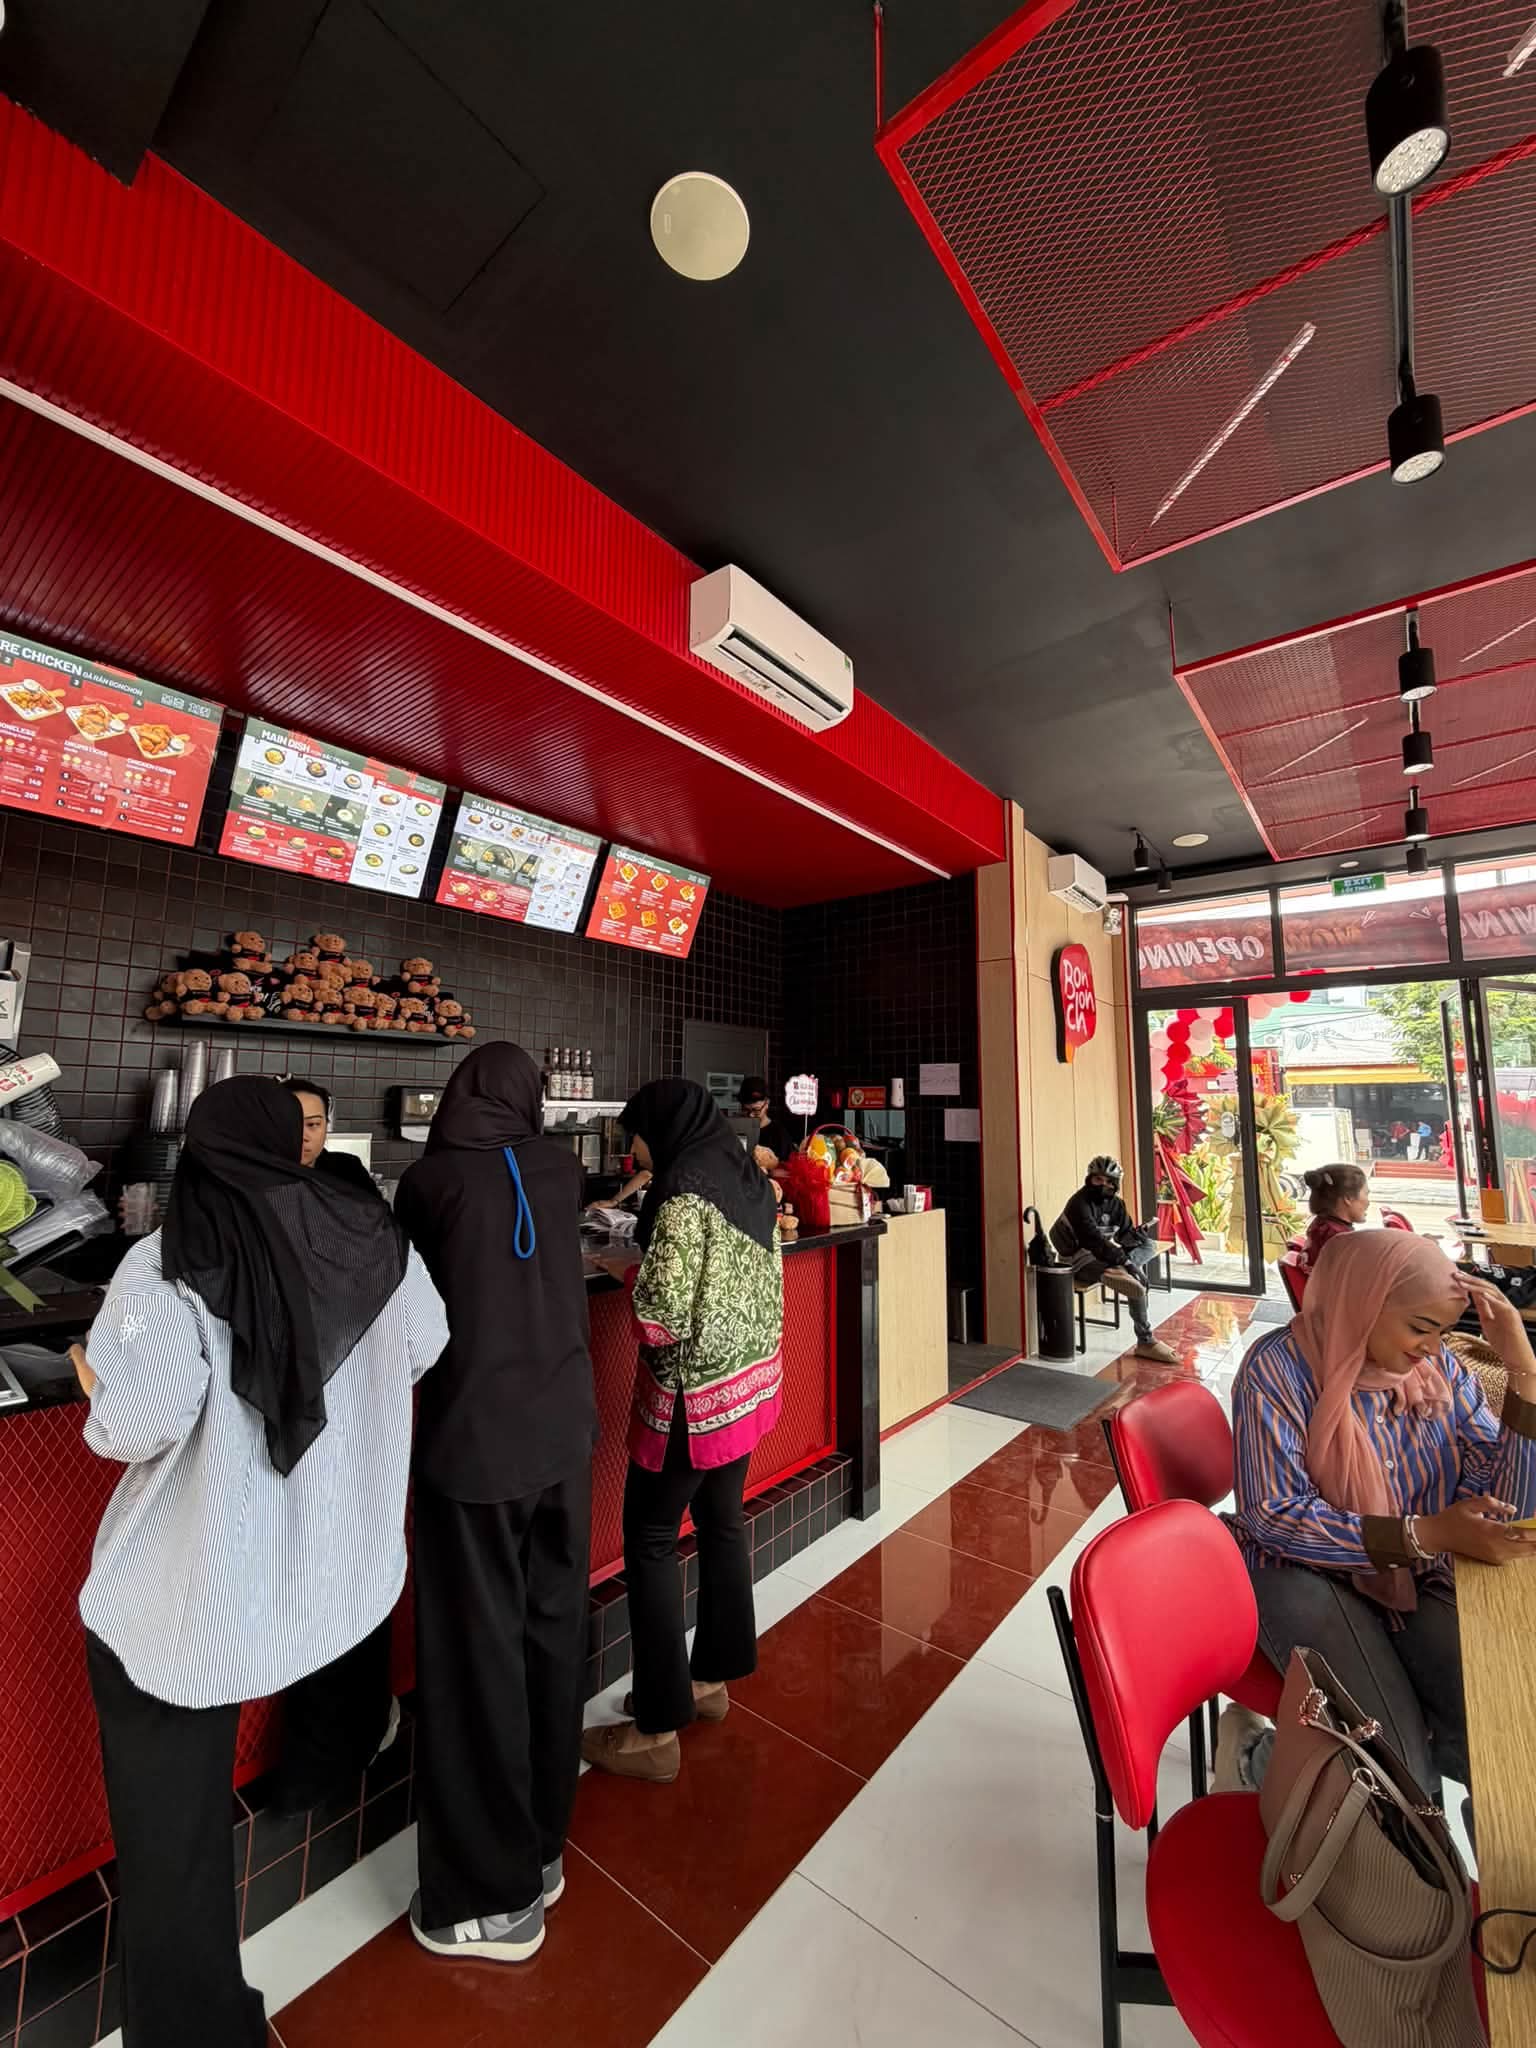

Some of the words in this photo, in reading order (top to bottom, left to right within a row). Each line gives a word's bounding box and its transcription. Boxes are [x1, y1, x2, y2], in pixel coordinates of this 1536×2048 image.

[21, 647, 82, 677] CHICKEN
[261, 729, 288, 746] MAIN
[287, 739, 312, 753] DISH
[471, 800, 496, 816] SALAD
[1343, 876, 1374, 888] EXIT
